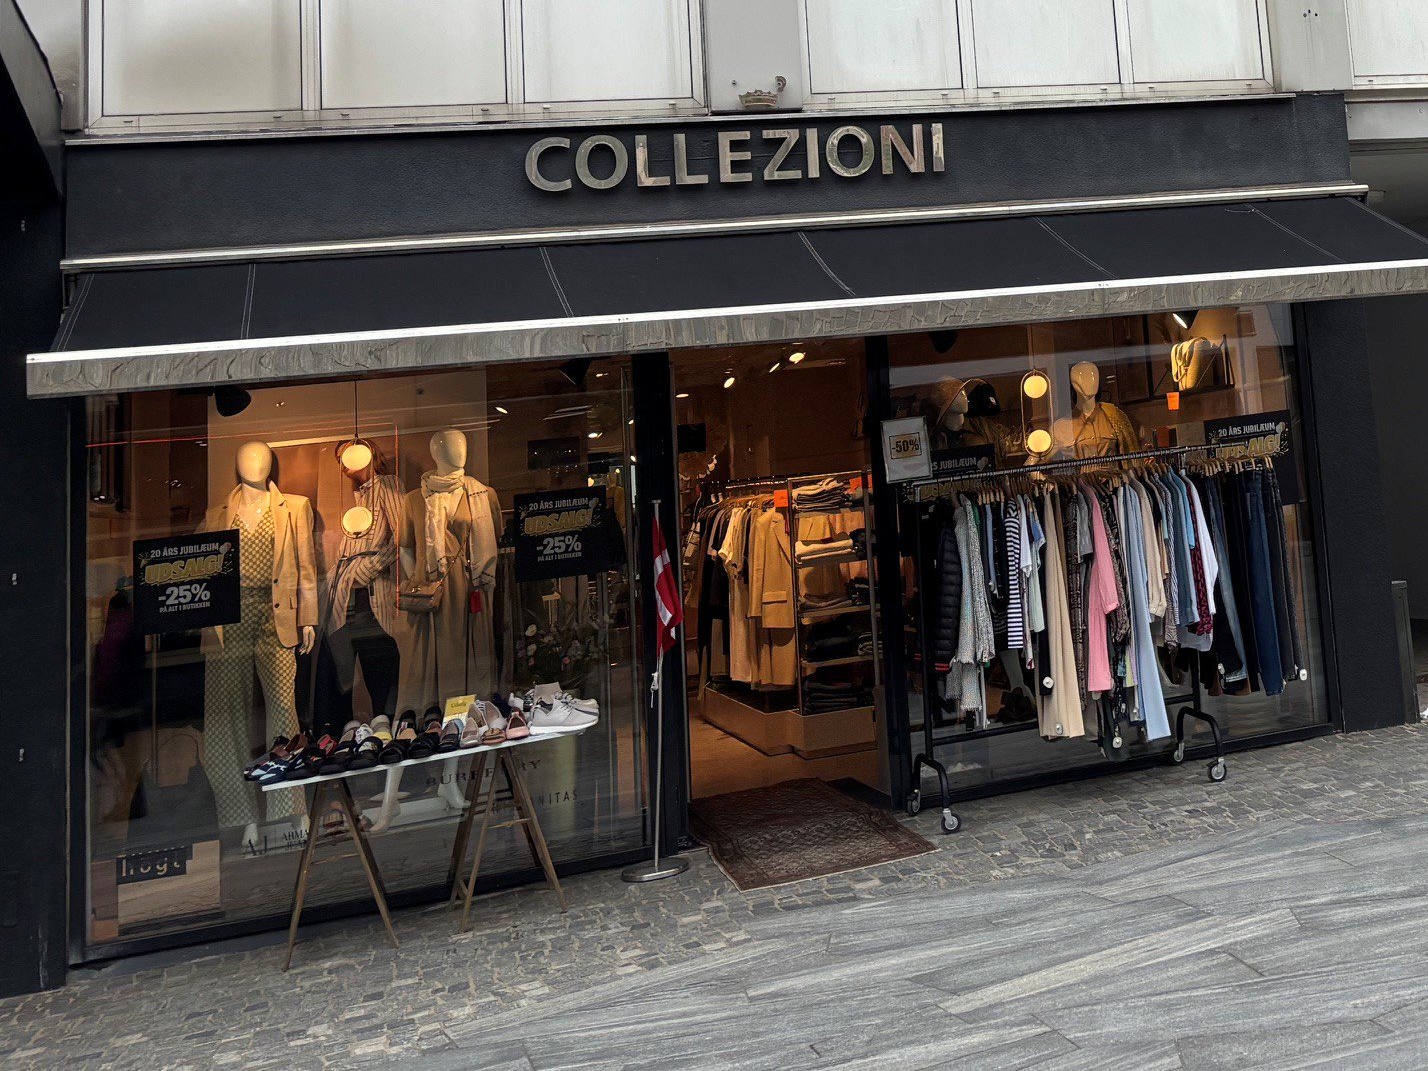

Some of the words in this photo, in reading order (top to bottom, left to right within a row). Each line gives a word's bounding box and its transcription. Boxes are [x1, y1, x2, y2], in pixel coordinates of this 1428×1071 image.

[524, 123, 946, 193] COLLEZIONI
[1228, 426, 1242, 436] ÅRS
[1243, 422, 1275, 434] JUBILÆUM
[892, 439, 919, 453] -50%
[529, 503, 538, 511] 20
[539, 500, 553, 509] ÅRS
[150, 550, 160, 558] 20
[162, 547, 178, 556] ÅRS
[180, 543, 219, 555] JUBILÆUM
[537, 535, 582, 555] -25%
[159, 583, 210, 605] -25%
